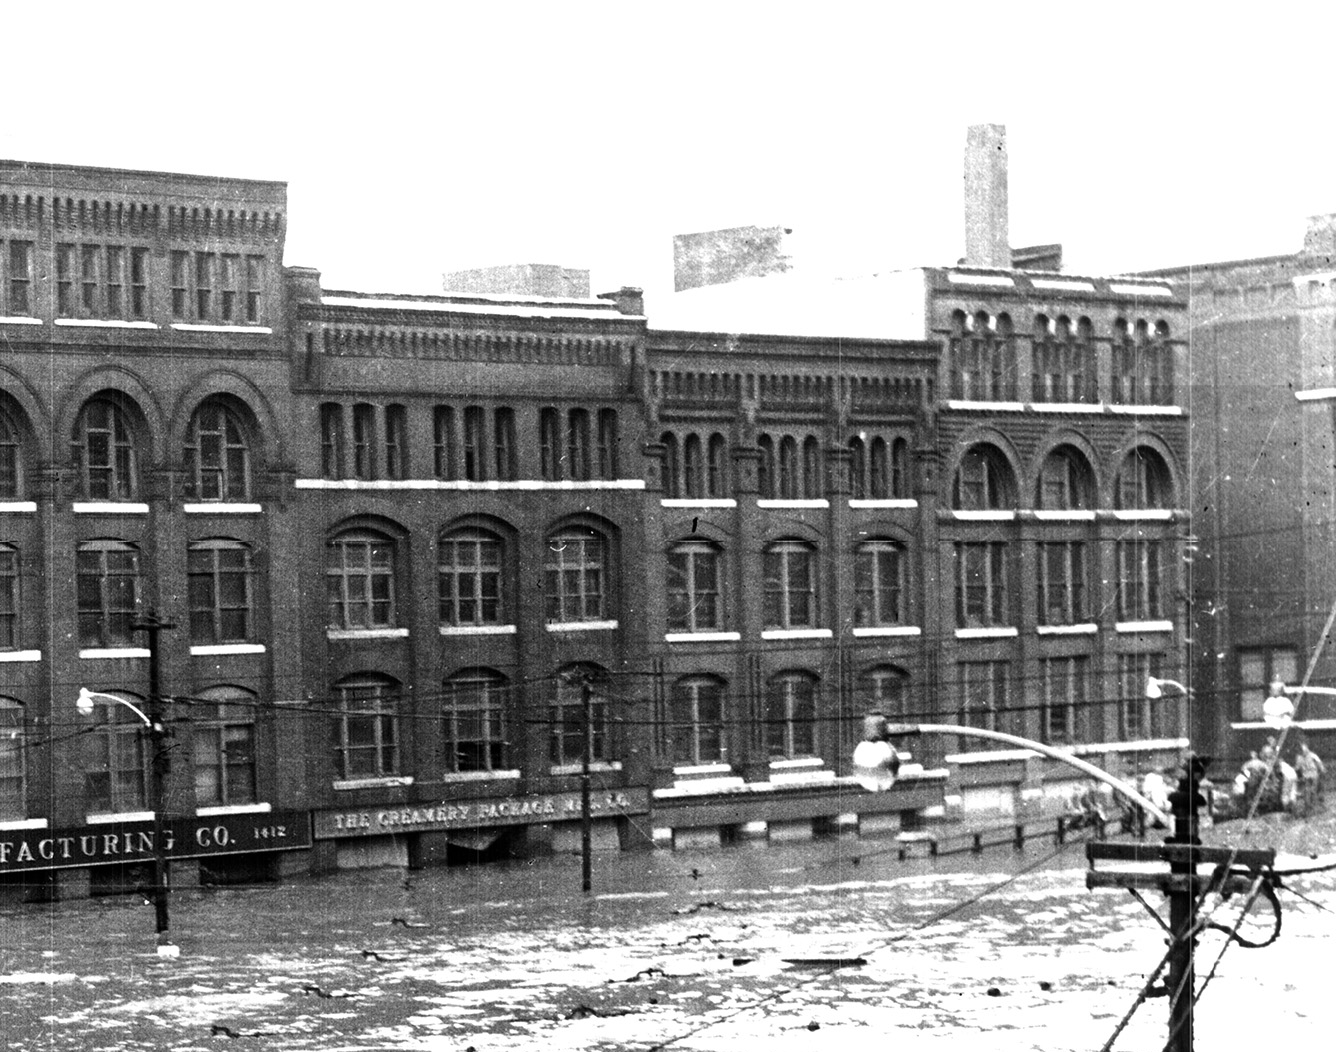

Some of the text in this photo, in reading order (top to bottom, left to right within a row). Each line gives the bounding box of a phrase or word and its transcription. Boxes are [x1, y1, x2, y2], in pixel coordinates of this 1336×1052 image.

[334, 813, 370, 829] THE
[377, 804, 468, 826] CREAMERY
[477, 799, 554, 818] PACKAGE
[195, 825, 236, 847] CO.
